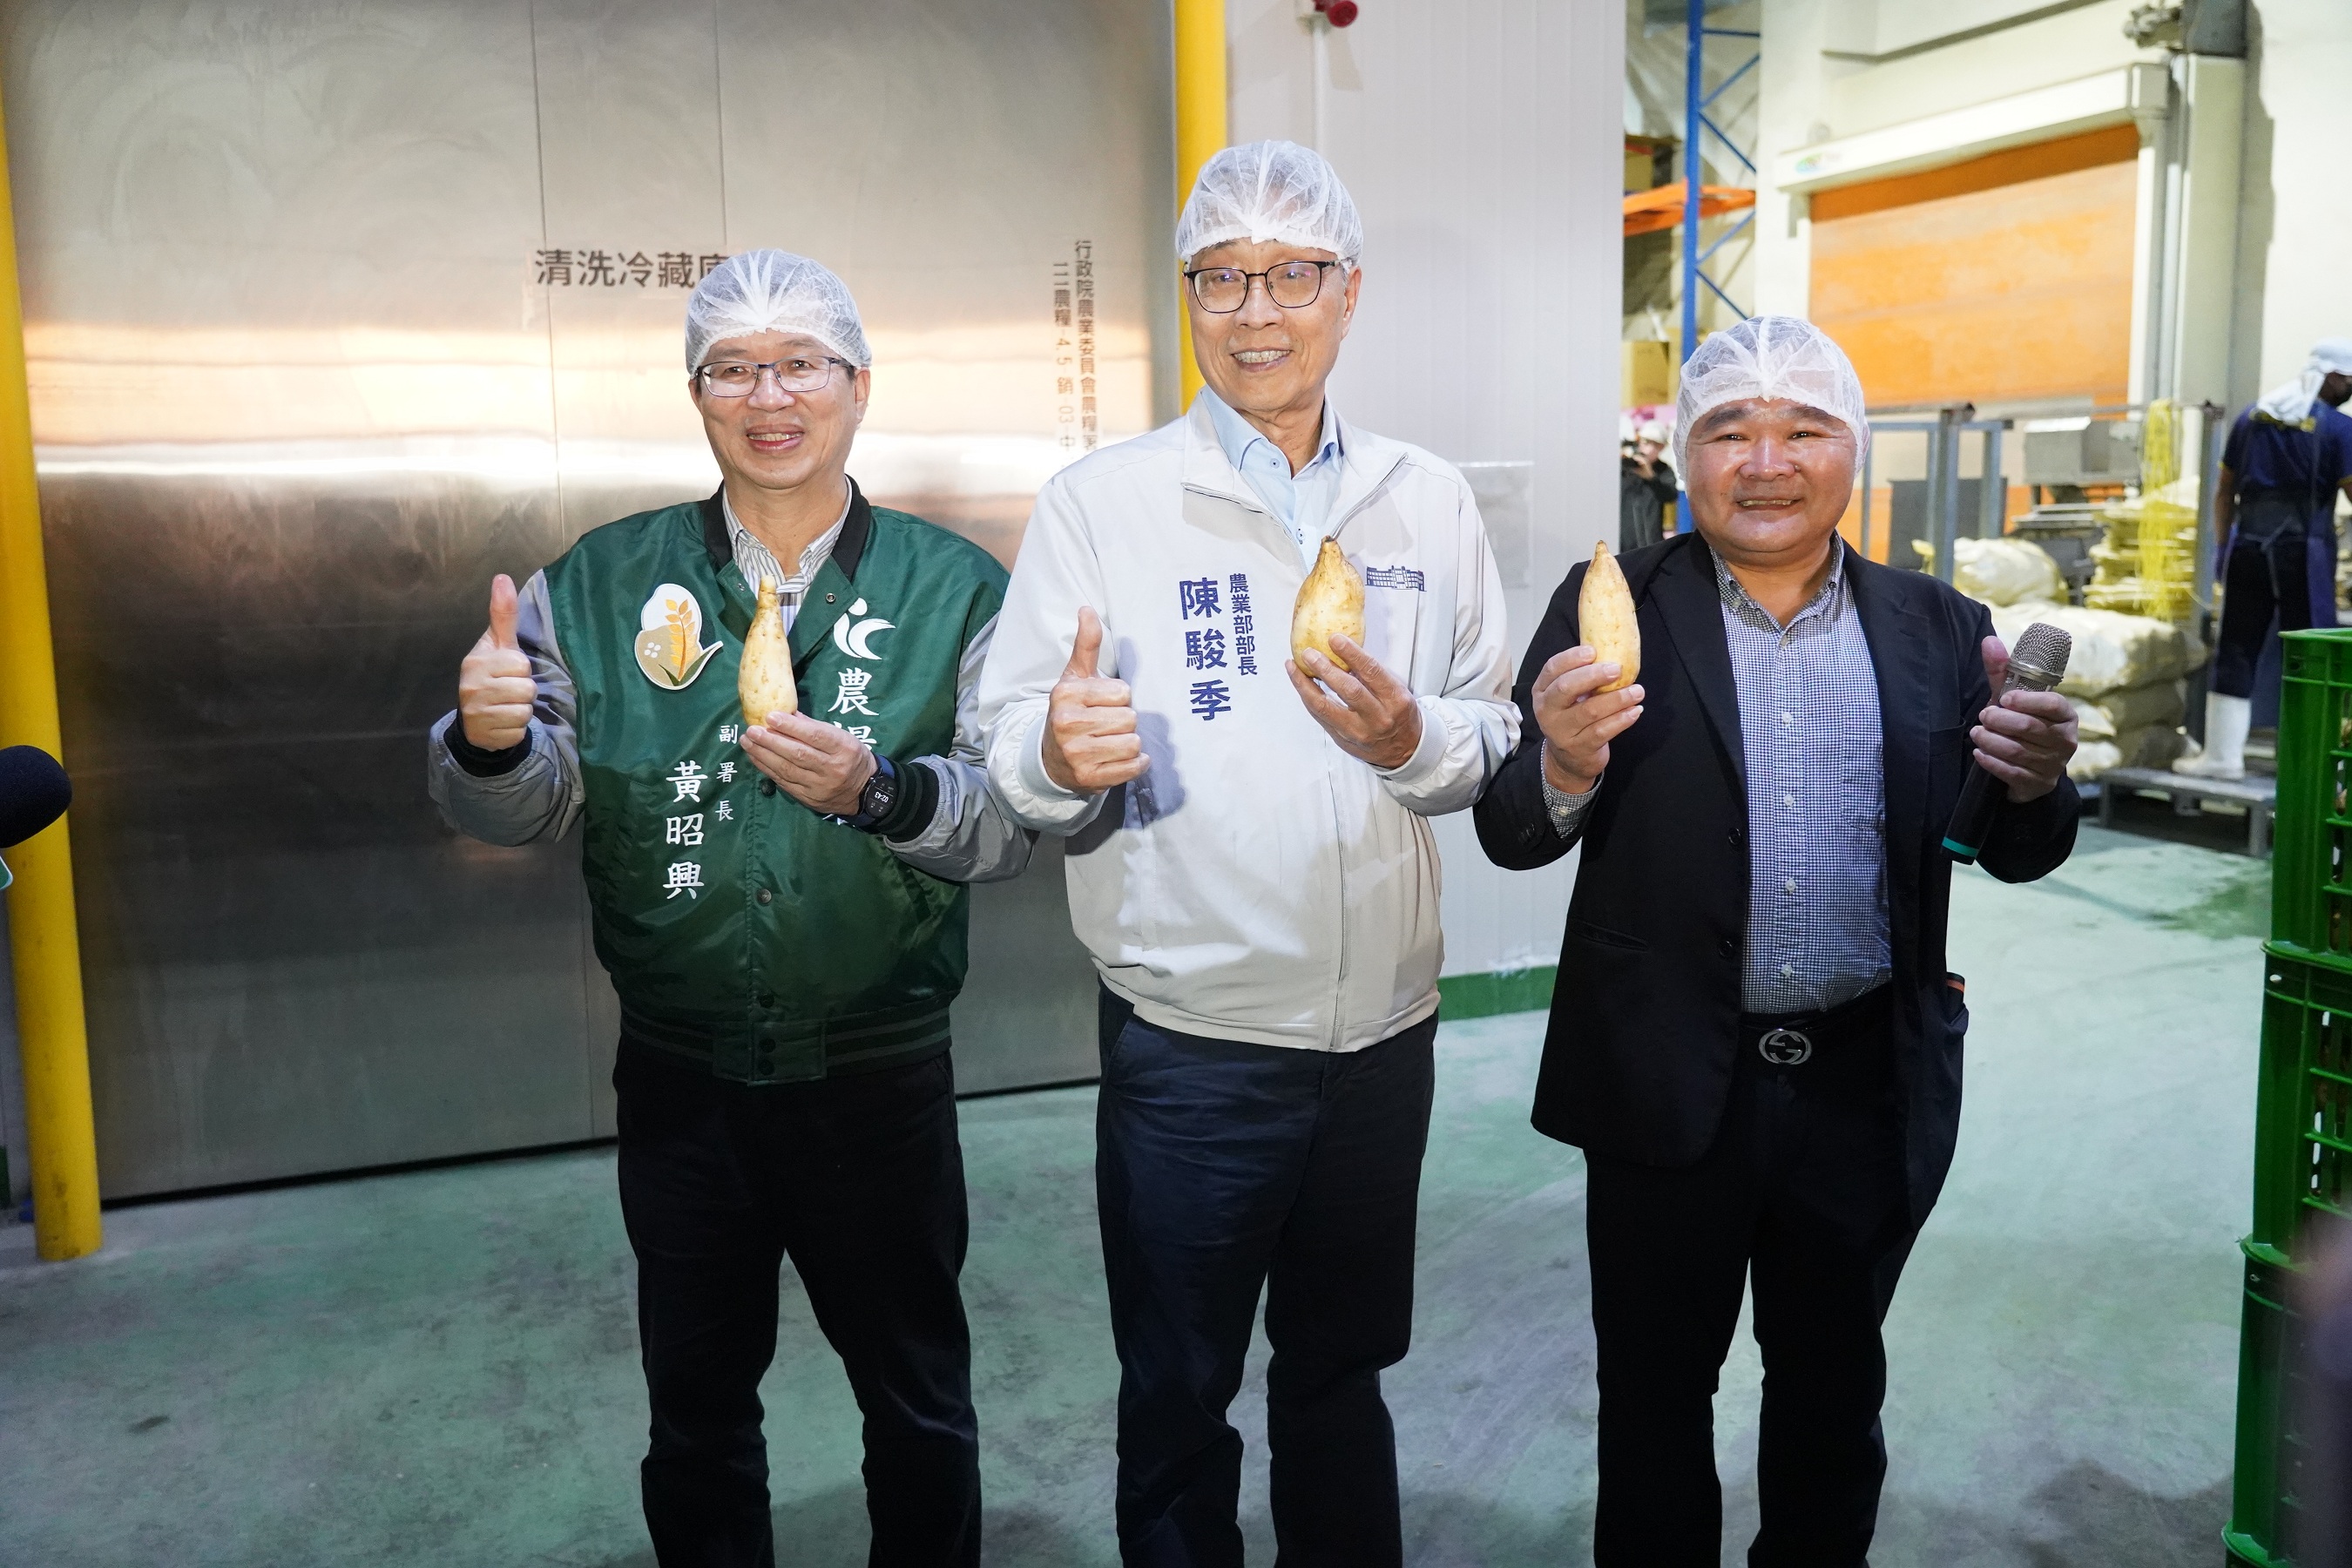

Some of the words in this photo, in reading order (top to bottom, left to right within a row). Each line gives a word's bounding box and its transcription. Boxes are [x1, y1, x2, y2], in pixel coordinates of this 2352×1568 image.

[1179, 577, 1232, 721] 陳駿季
[1229, 572, 1258, 676] 農業部部長
[714, 724, 739, 821] 副署長
[875, 791, 889, 803] 02:43
[662, 760, 709, 900] 黃昭興
